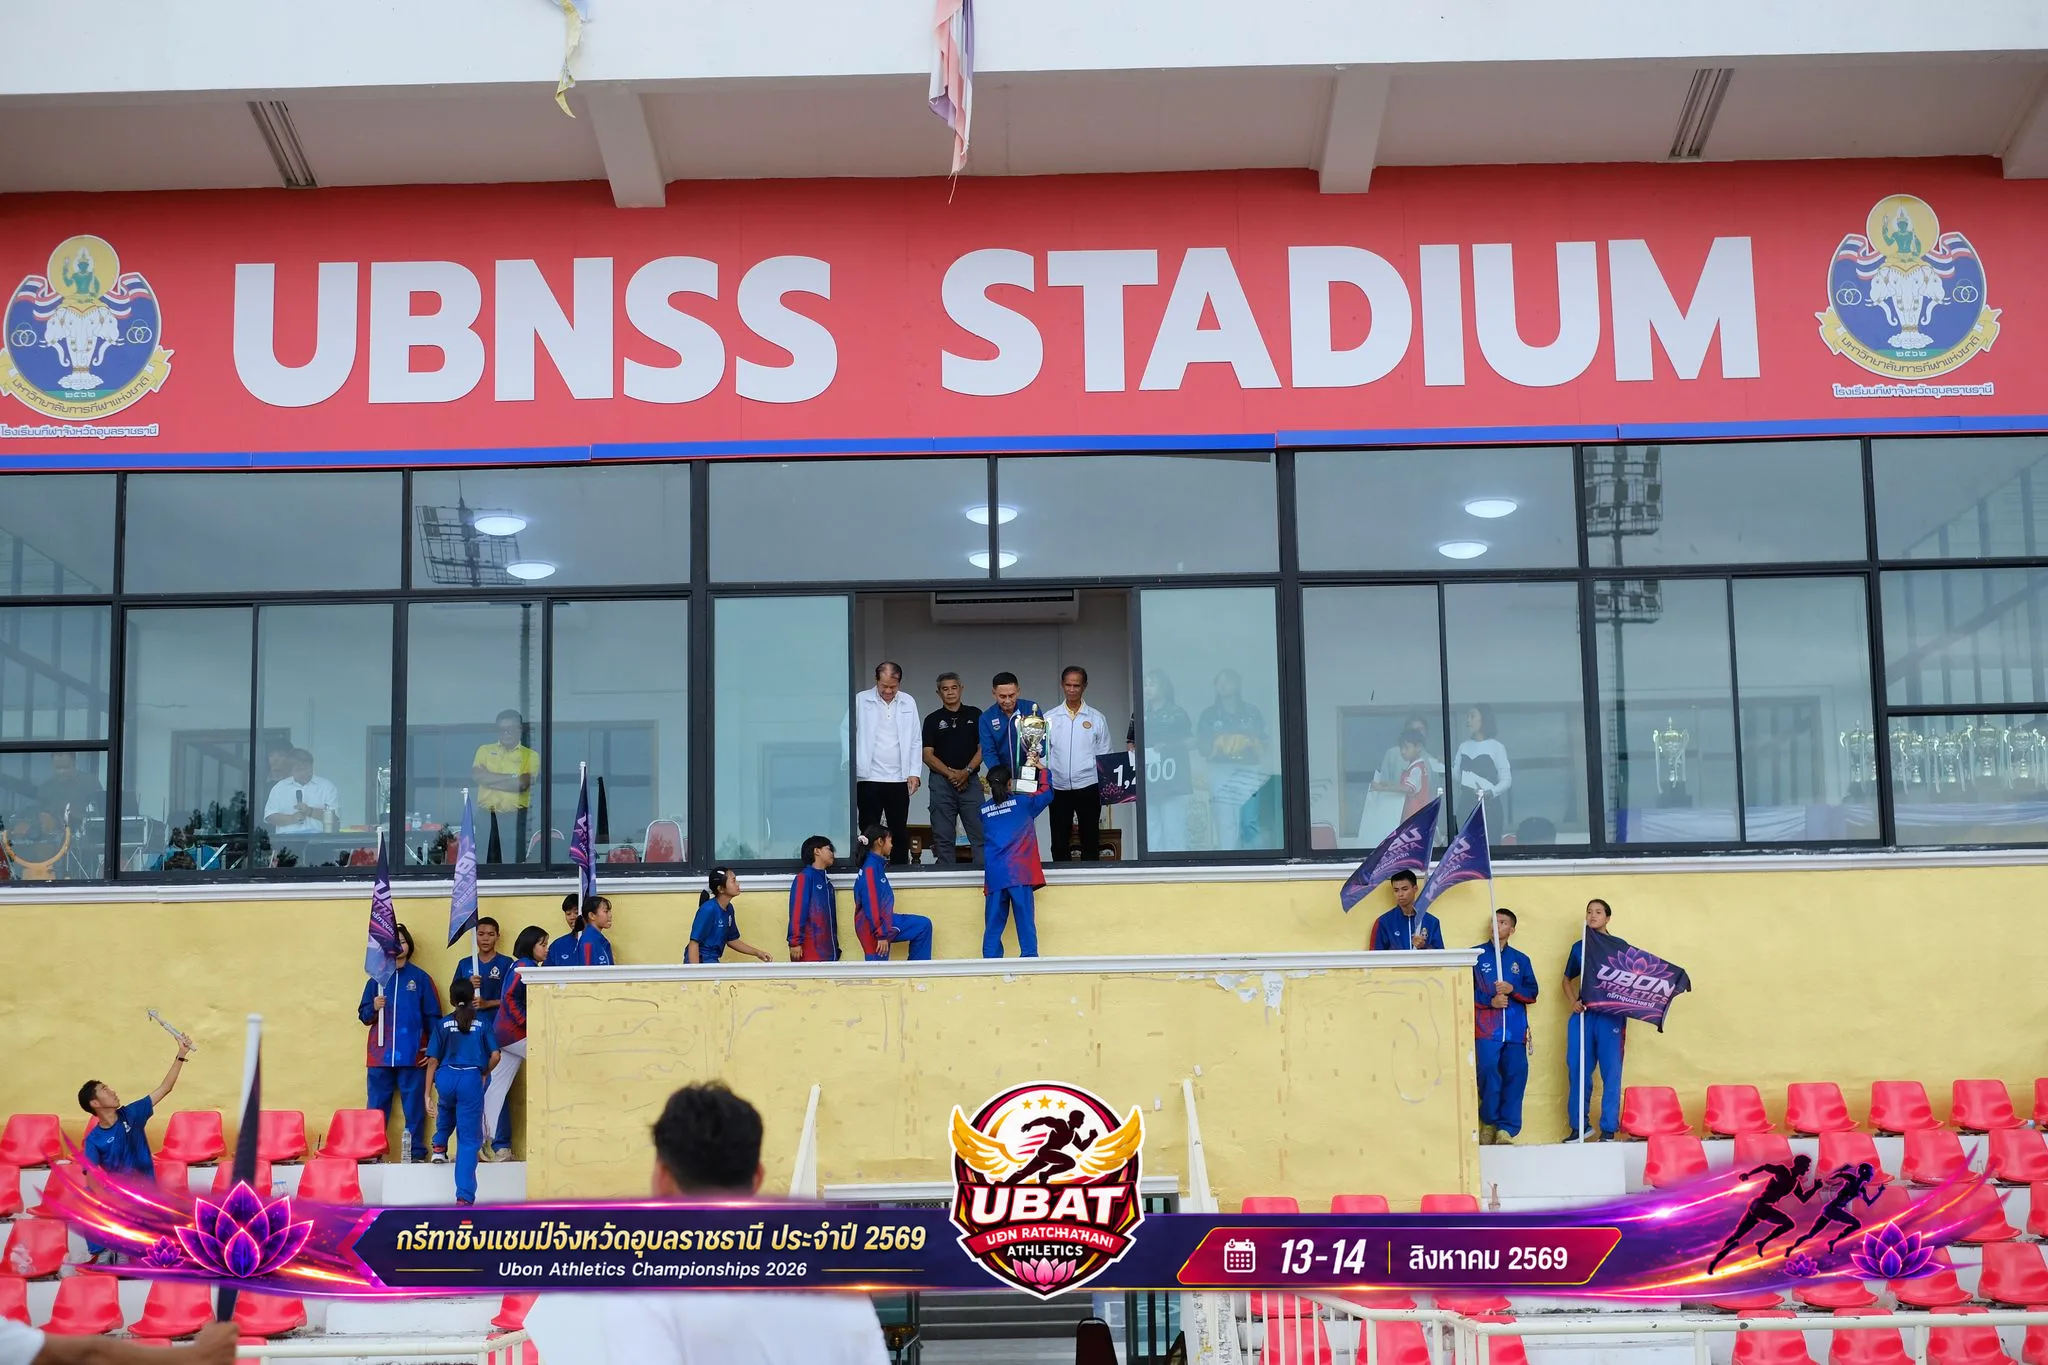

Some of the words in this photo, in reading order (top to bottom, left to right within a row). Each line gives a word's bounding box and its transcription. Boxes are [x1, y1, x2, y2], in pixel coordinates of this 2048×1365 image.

[234, 256, 837, 408] UBNSS
[941, 236, 1761, 396] STADIUM
[1594, 980, 1669, 1005] ATHLETICS
[1596, 964, 1675, 996] UBON
